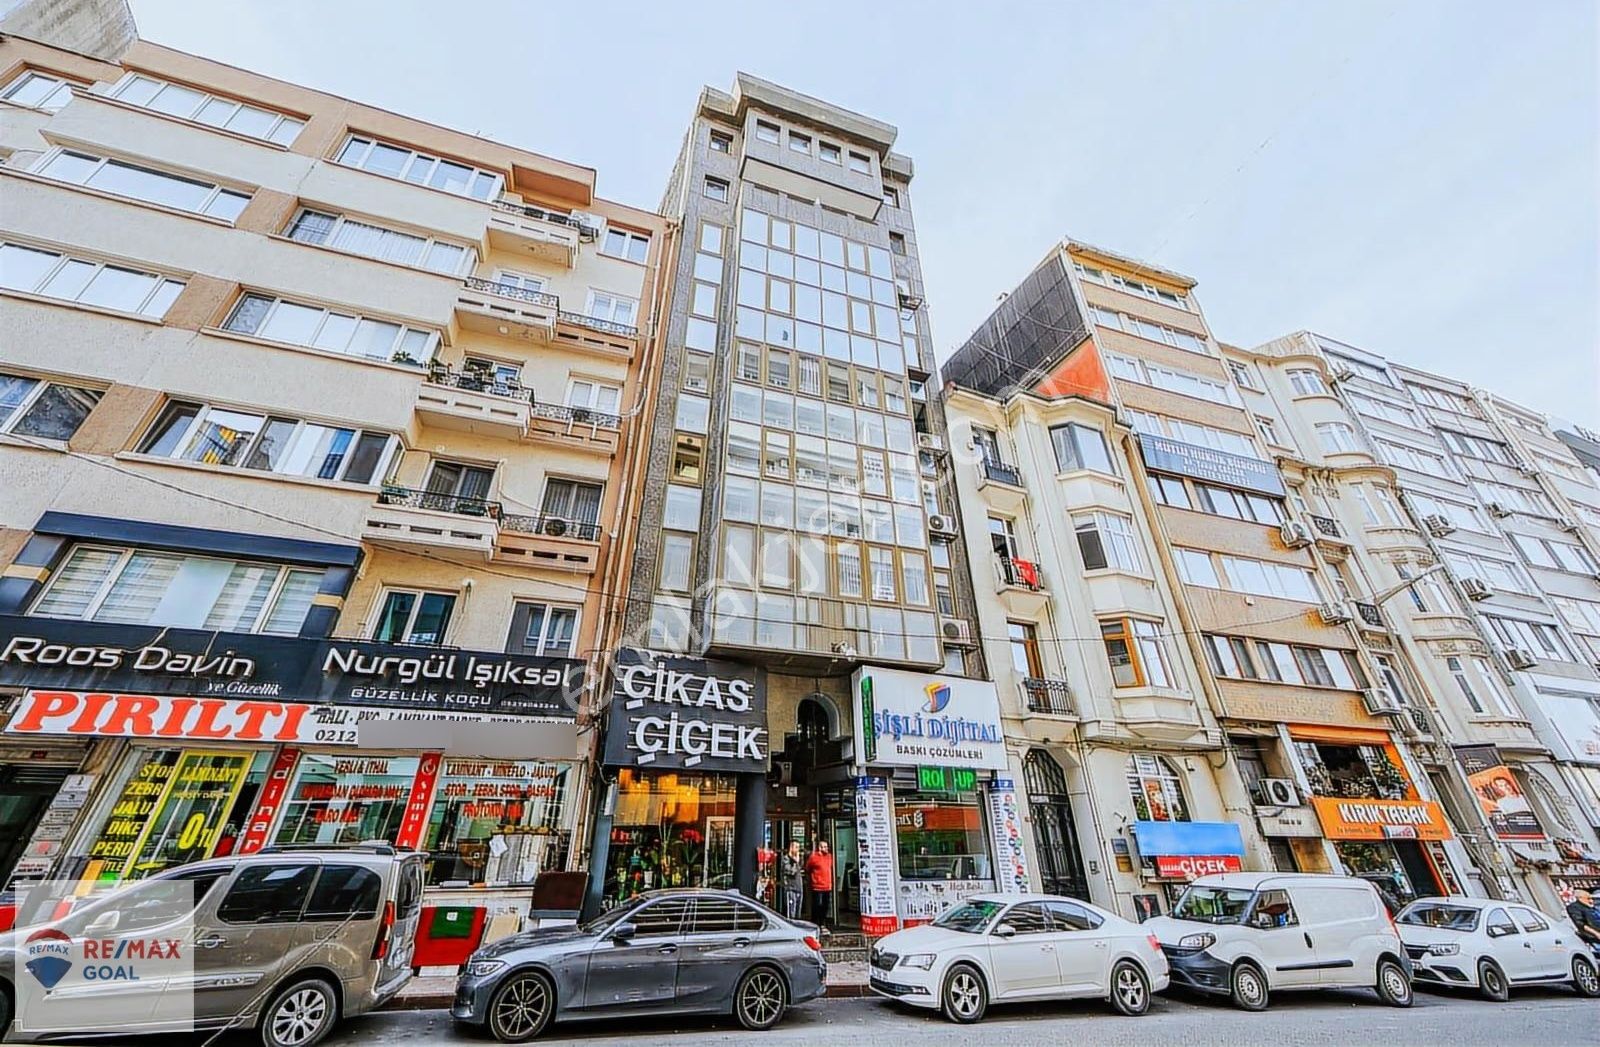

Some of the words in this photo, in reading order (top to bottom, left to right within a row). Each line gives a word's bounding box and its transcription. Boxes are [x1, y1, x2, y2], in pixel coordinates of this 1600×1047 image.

[0, 636, 122, 668] Roos
[133, 647, 255, 677] Davin
[322, 647, 455, 683] Nurgül
[465, 657, 571, 687] Işıksal
[208, 683, 224, 694] ve
[226, 681, 282, 697] Güzellik
[350, 686, 439, 703] GÜZELLİK
[445, 694, 492, 707] KOÇU
[623, 662, 750, 712] ÇİKAS
[14, 691, 311, 741] PIRILTI
[315, 729, 356, 742] 0212
[635, 712, 763, 767] ÇİÇEK
[896, 745, 927, 756] BASKI
[1180, 857, 1227, 875] ÇİÇEK
